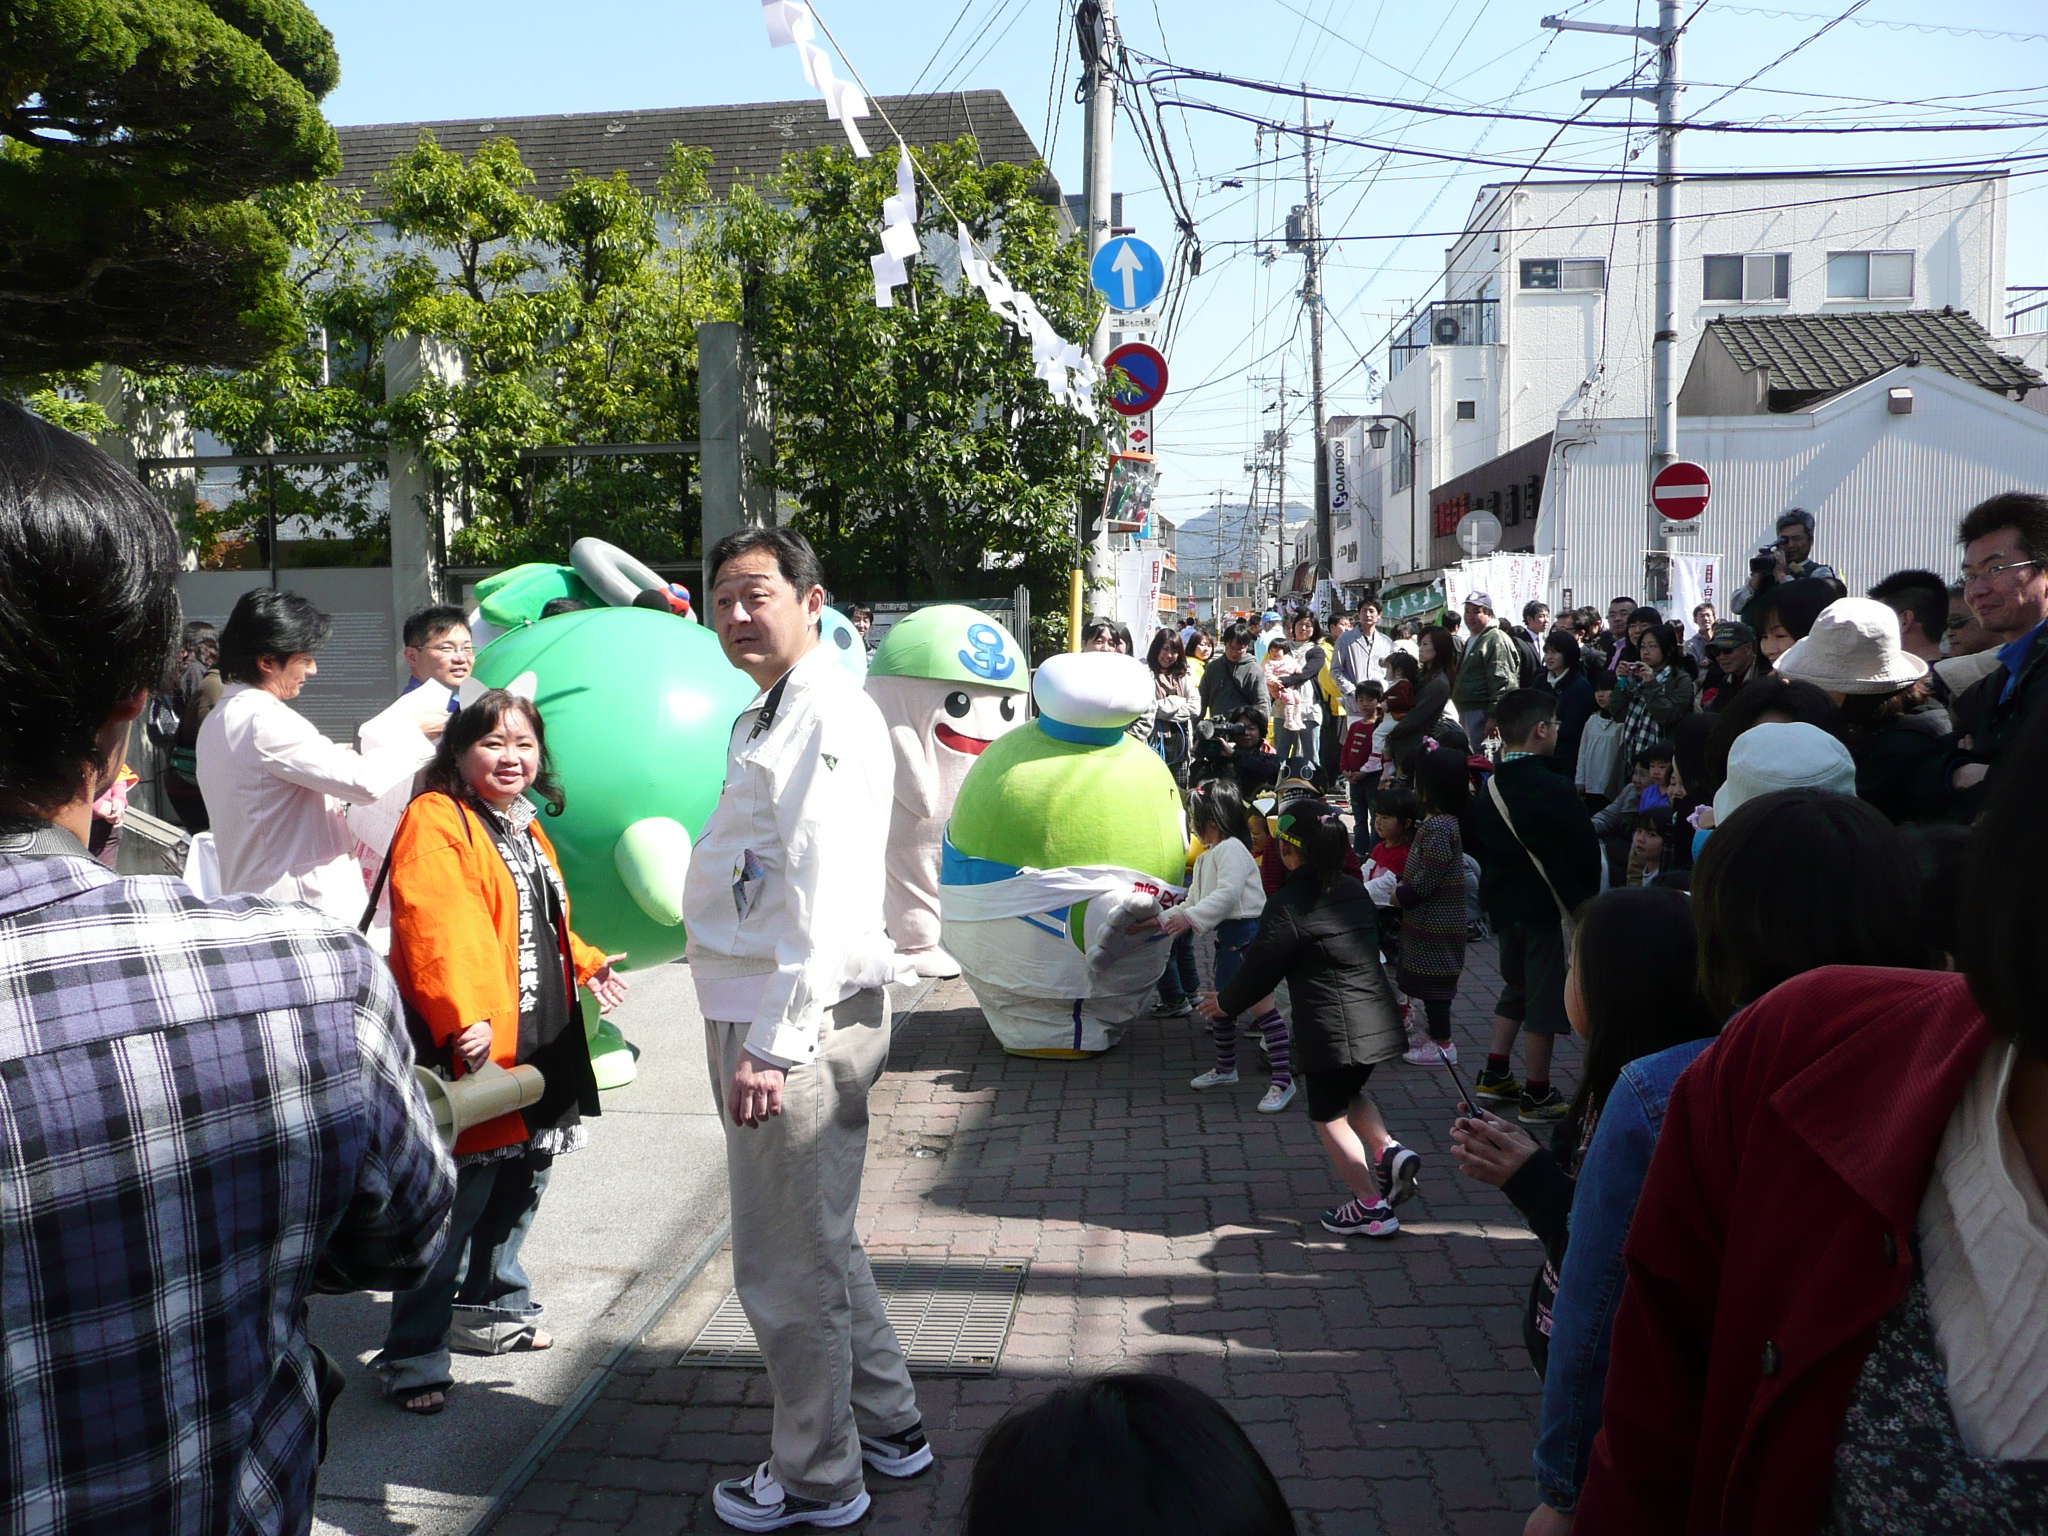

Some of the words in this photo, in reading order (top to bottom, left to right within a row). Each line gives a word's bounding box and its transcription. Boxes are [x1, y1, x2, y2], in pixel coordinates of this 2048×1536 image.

[1112, 317, 1156, 328] 二輪のものを除く
[1335, 440, 1346, 492] KOKUYO
[1662, 525, 1699, 534] 二輪のものを除く
